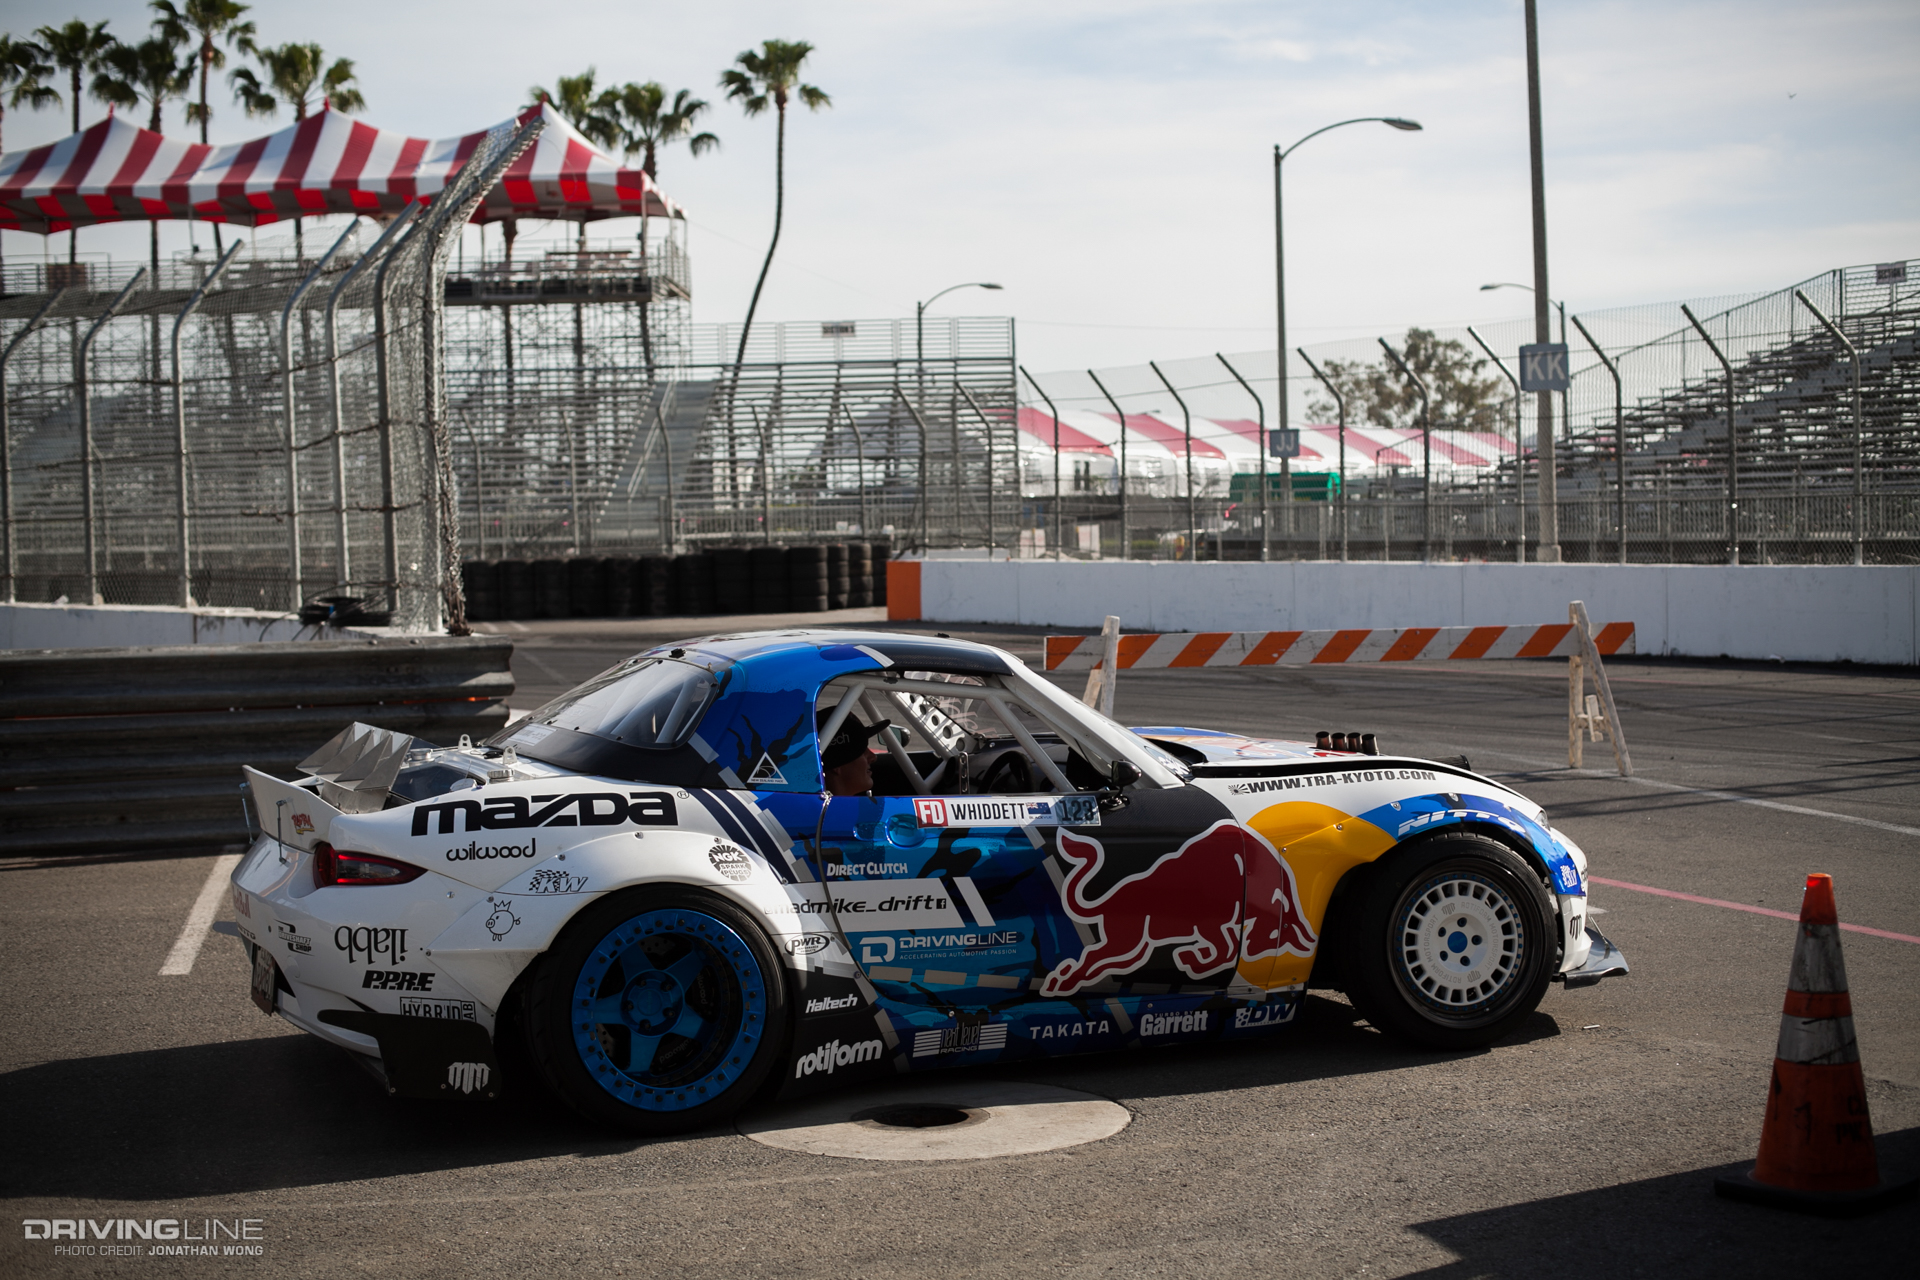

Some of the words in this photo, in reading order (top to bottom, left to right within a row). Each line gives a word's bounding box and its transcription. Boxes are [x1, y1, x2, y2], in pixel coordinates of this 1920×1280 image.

[1526, 351, 1566, 381] KK
[1276, 432, 1295, 452] JJ
[1248, 770, 1436, 794] WWW.TRA-KYOTO.COM
[918, 801, 945, 825] FD
[951, 803, 1025, 821] WHIDDETT
[1060, 800, 1095, 822] 123
[1398, 808, 1527, 837] NITTO
[446, 837, 536, 862] wilwood
[713, 852, 743, 862] NGK
[536, 876, 588, 894] KW
[949, 950, 988, 958] AUTOMOTIVE
[805, 993, 858, 1014] Haltech
[941, 1022, 960, 1048] next
[960, 1020, 981, 1046] level
[1029, 1020, 1110, 1040] TAKATA
[1140, 1011, 1209, 1037] Garrett
[795, 1038, 883, 1079] rotiform
[939, 1045, 978, 1055] RACING
